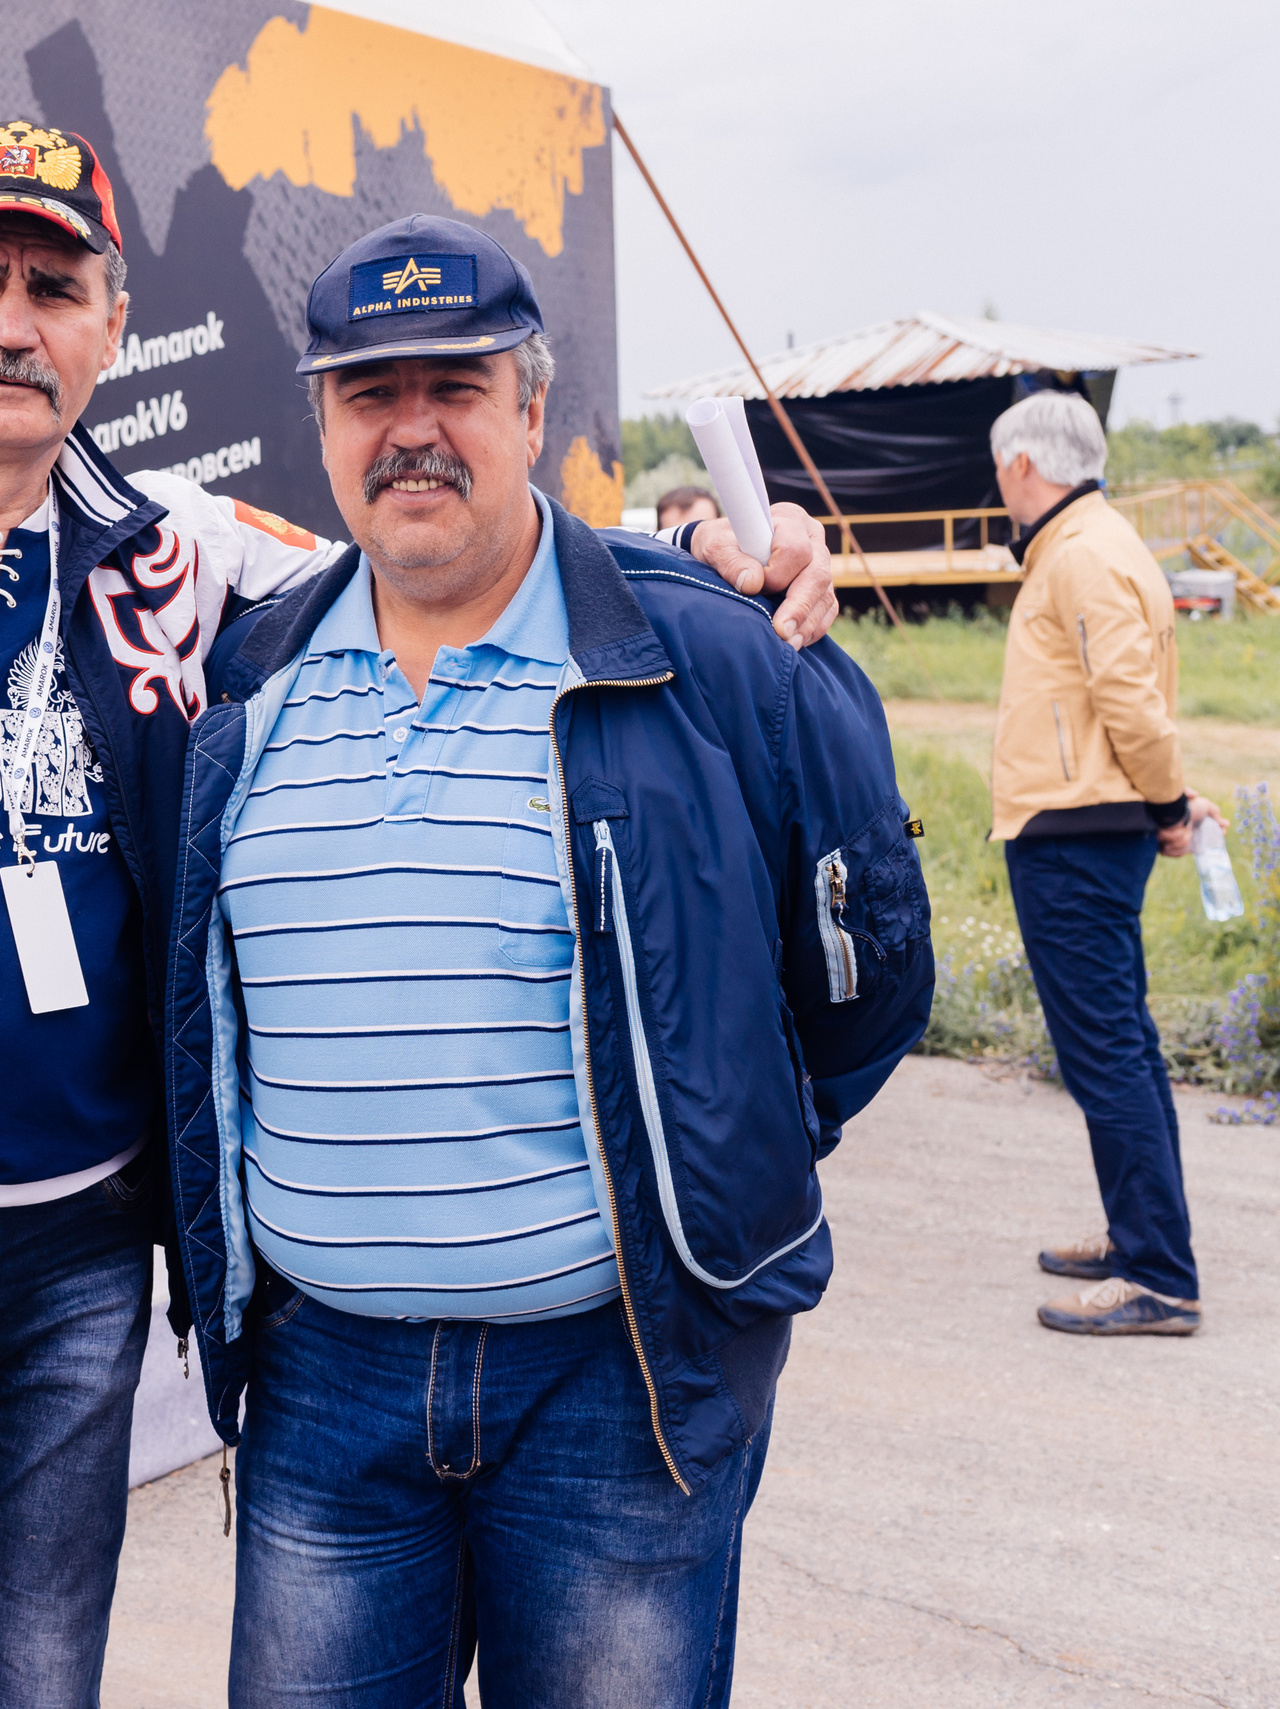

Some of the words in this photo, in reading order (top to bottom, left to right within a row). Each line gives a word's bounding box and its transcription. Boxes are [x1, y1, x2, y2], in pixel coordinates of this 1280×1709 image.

[353, 301, 392, 315] ALPHA
[397, 295, 472, 308] INDUSTRIES
[89, 390, 188, 453] arokV6
[48, 600, 58, 633] AMAROK
[36, 663, 48, 697] AMAROK
[21, 727, 35, 758] AMAROK
[13, 823, 111, 854] Future
